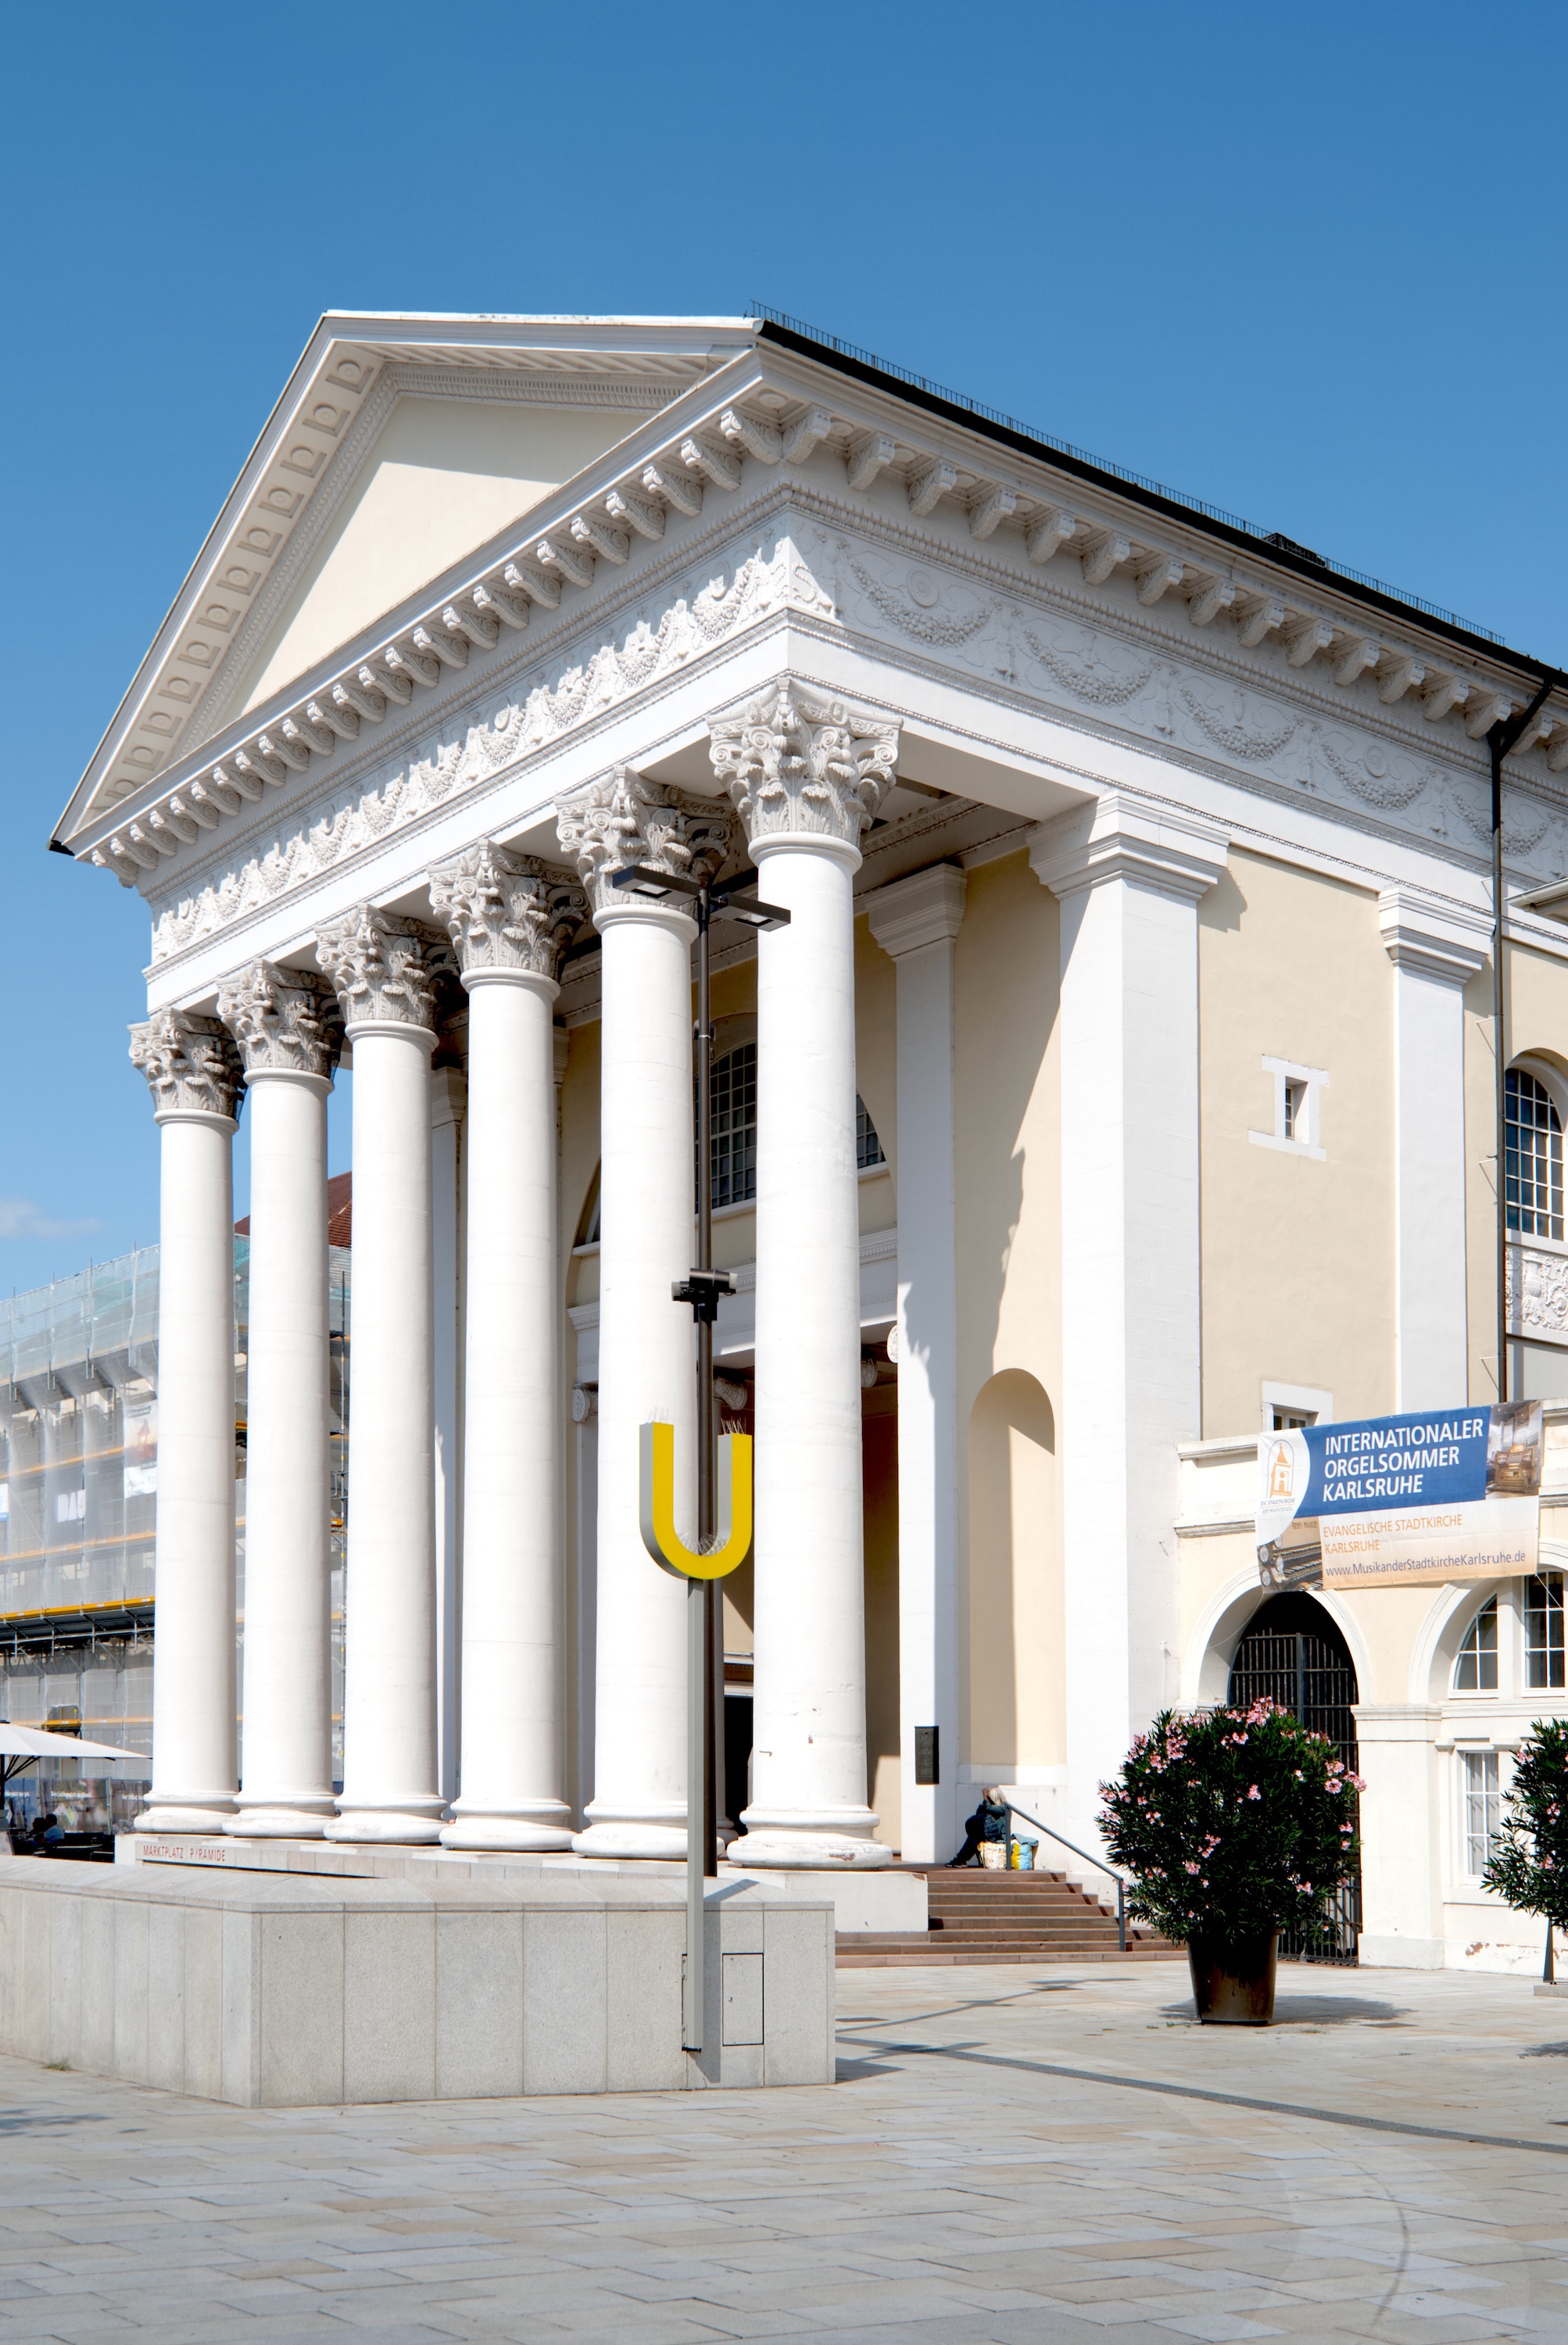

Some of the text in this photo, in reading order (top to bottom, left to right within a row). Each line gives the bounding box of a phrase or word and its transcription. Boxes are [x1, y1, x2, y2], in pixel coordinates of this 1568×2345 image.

[1326, 1418, 1484, 1455] INTERNATIONALER
[1324, 1447, 1459, 1479] ORGELSOMMER
[639, 1422, 752, 1580] U
[1323, 1474, 1423, 1502] KARLSRUHE
[1323, 1514, 1462, 1538] EVANGELISCHE STADTKIRCHE
[1324, 1540, 1380, 1555] KARLSRUHE
[1326, 1550, 1526, 1577] www.MusikanderStadtkircheKarlsruhe.de
[143, 1845, 226, 1862] MARKTPLATZ PYRAMIDE
